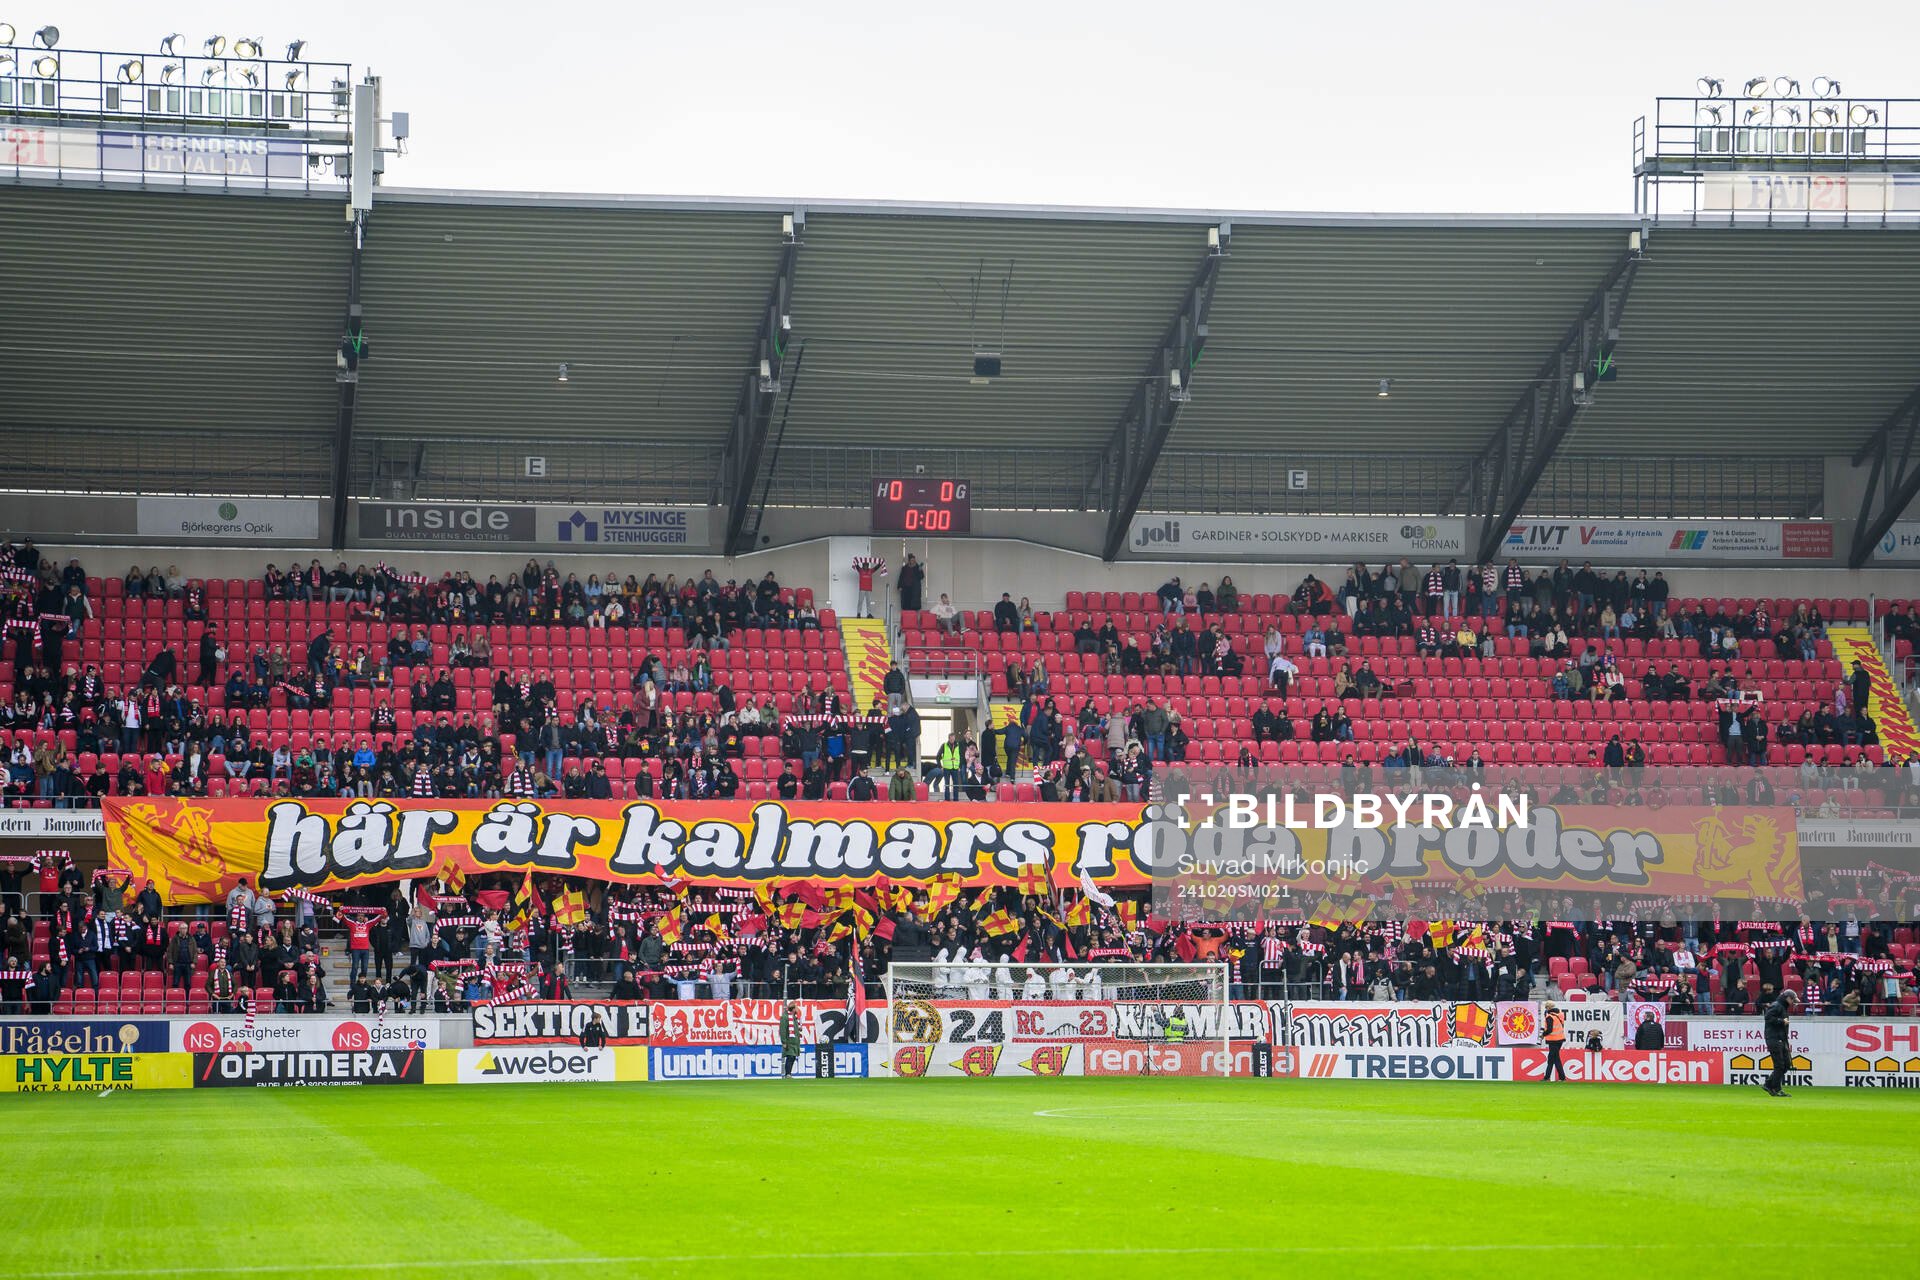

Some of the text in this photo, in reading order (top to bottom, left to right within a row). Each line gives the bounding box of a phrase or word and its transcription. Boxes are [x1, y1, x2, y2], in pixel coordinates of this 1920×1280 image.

[132, 134, 268, 155] LEGENDENS
[147, 153, 254, 174] UTVALDA
[529, 458, 541, 475] E
[1292, 471, 1304, 488] E
[181, 521, 273, 535] Björkegrens Optik
[385, 508, 510, 530] inside
[603, 510, 687, 526] MYSINGE
[905, 509, 951, 530] 0:00
[385, 531, 511, 541] QUALITY MENS CLOTHES
[603, 530, 687, 543] STENHUGGERI
[1192, 530, 1389, 544] GARDINER SOLSKYDD MARKISER
[1529, 525, 1570, 545] IVT
[261, 801, 1664, 886] här är kalmars röda bröder
[1846, 830, 1913, 843] Barometern
[474, 1004, 647, 1039] SEKTION E
[693, 1001, 729, 1028] red
[1016, 1009, 1108, 1036] RC 23
[1114, 1003, 1265, 1040] KALMAR
[1571, 1009, 1611, 1021] INGEN
[222, 1026, 301, 1040] Fastigheter
[370, 1025, 427, 1044] gastro
[690, 1028, 732, 1041] brothers
[732, 1022, 816, 1045] KURN
[948, 1010, 1006, 1043] 24
[1703, 1030, 1734, 1039] BEST
[1745, 1030, 1799, 1039] KAR
[190, 1033, 215, 1048] NS
[338, 1032, 362, 1047] NS
[1845, 1024, 1919, 1052] SH
[16, 1056, 133, 1083] HYLTE
[220, 1053, 397, 1079] OPTIMERA
[502, 1050, 599, 1075] weber
[820, 1051, 830, 1078] SELECT
[1090, 1049, 1182, 1072] renta
[1200, 1049, 1295, 1073] rena
[1259, 1050, 1268, 1077] SELECT
[1345, 1054, 1506, 1079] TREBOLIT
